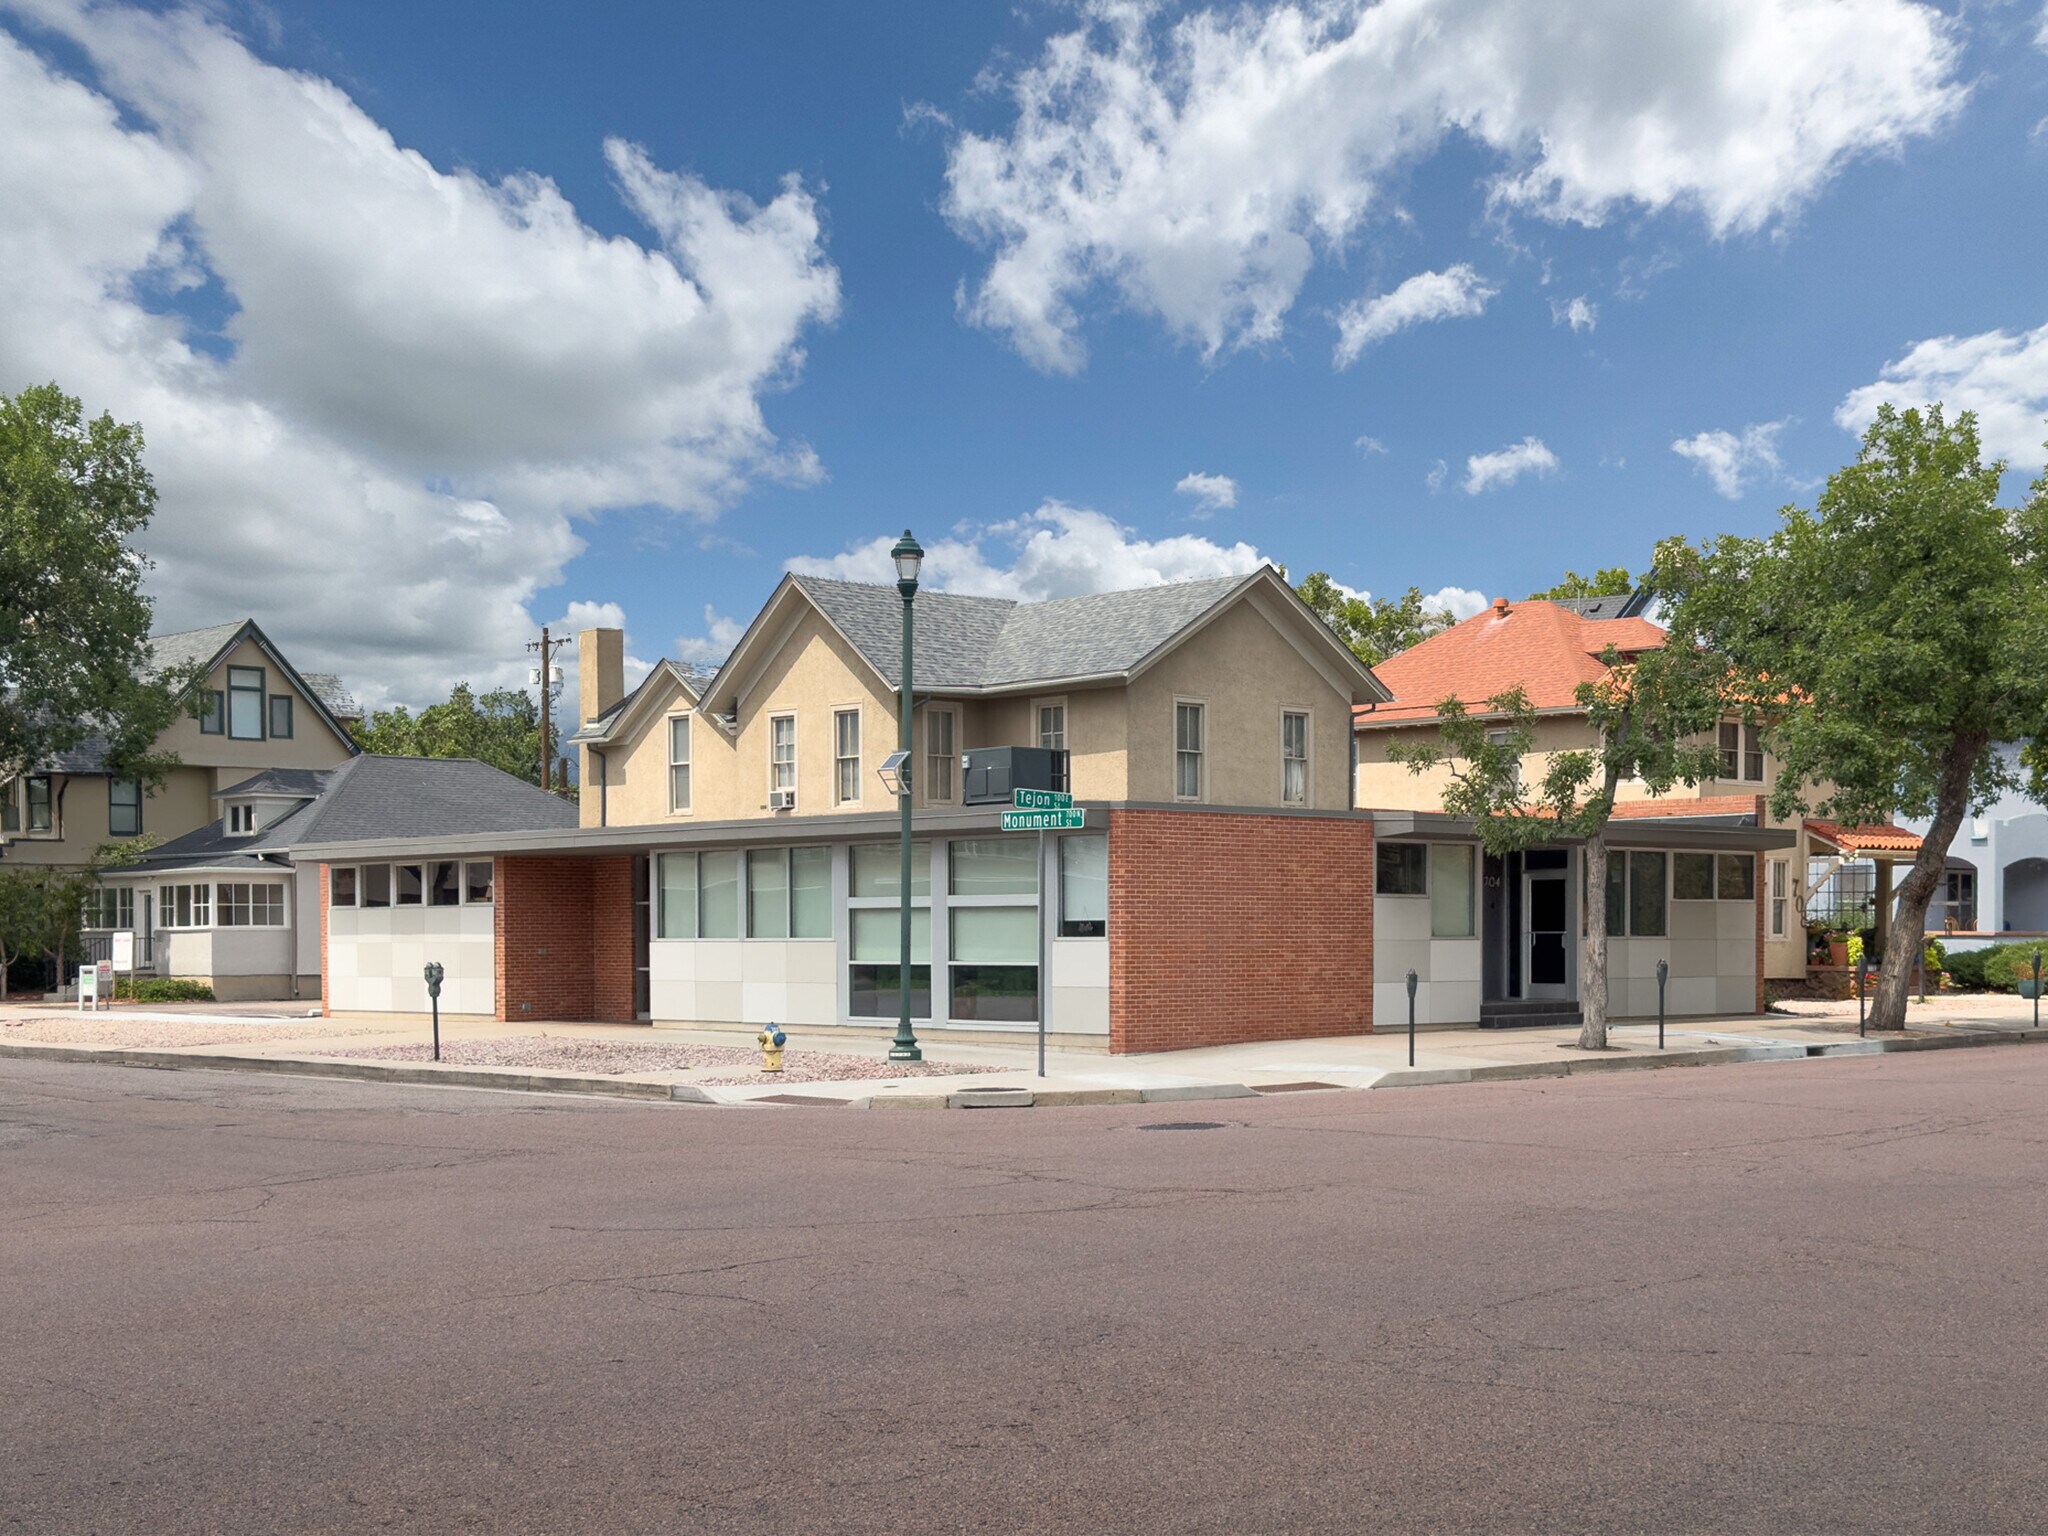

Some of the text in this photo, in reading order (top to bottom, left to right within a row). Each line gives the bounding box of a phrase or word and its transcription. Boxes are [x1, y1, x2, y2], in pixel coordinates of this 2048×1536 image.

[1020, 791, 1050, 808] Tejon
[1004, 811, 1062, 828] Monument
[1483, 876, 1500, 887] 704
